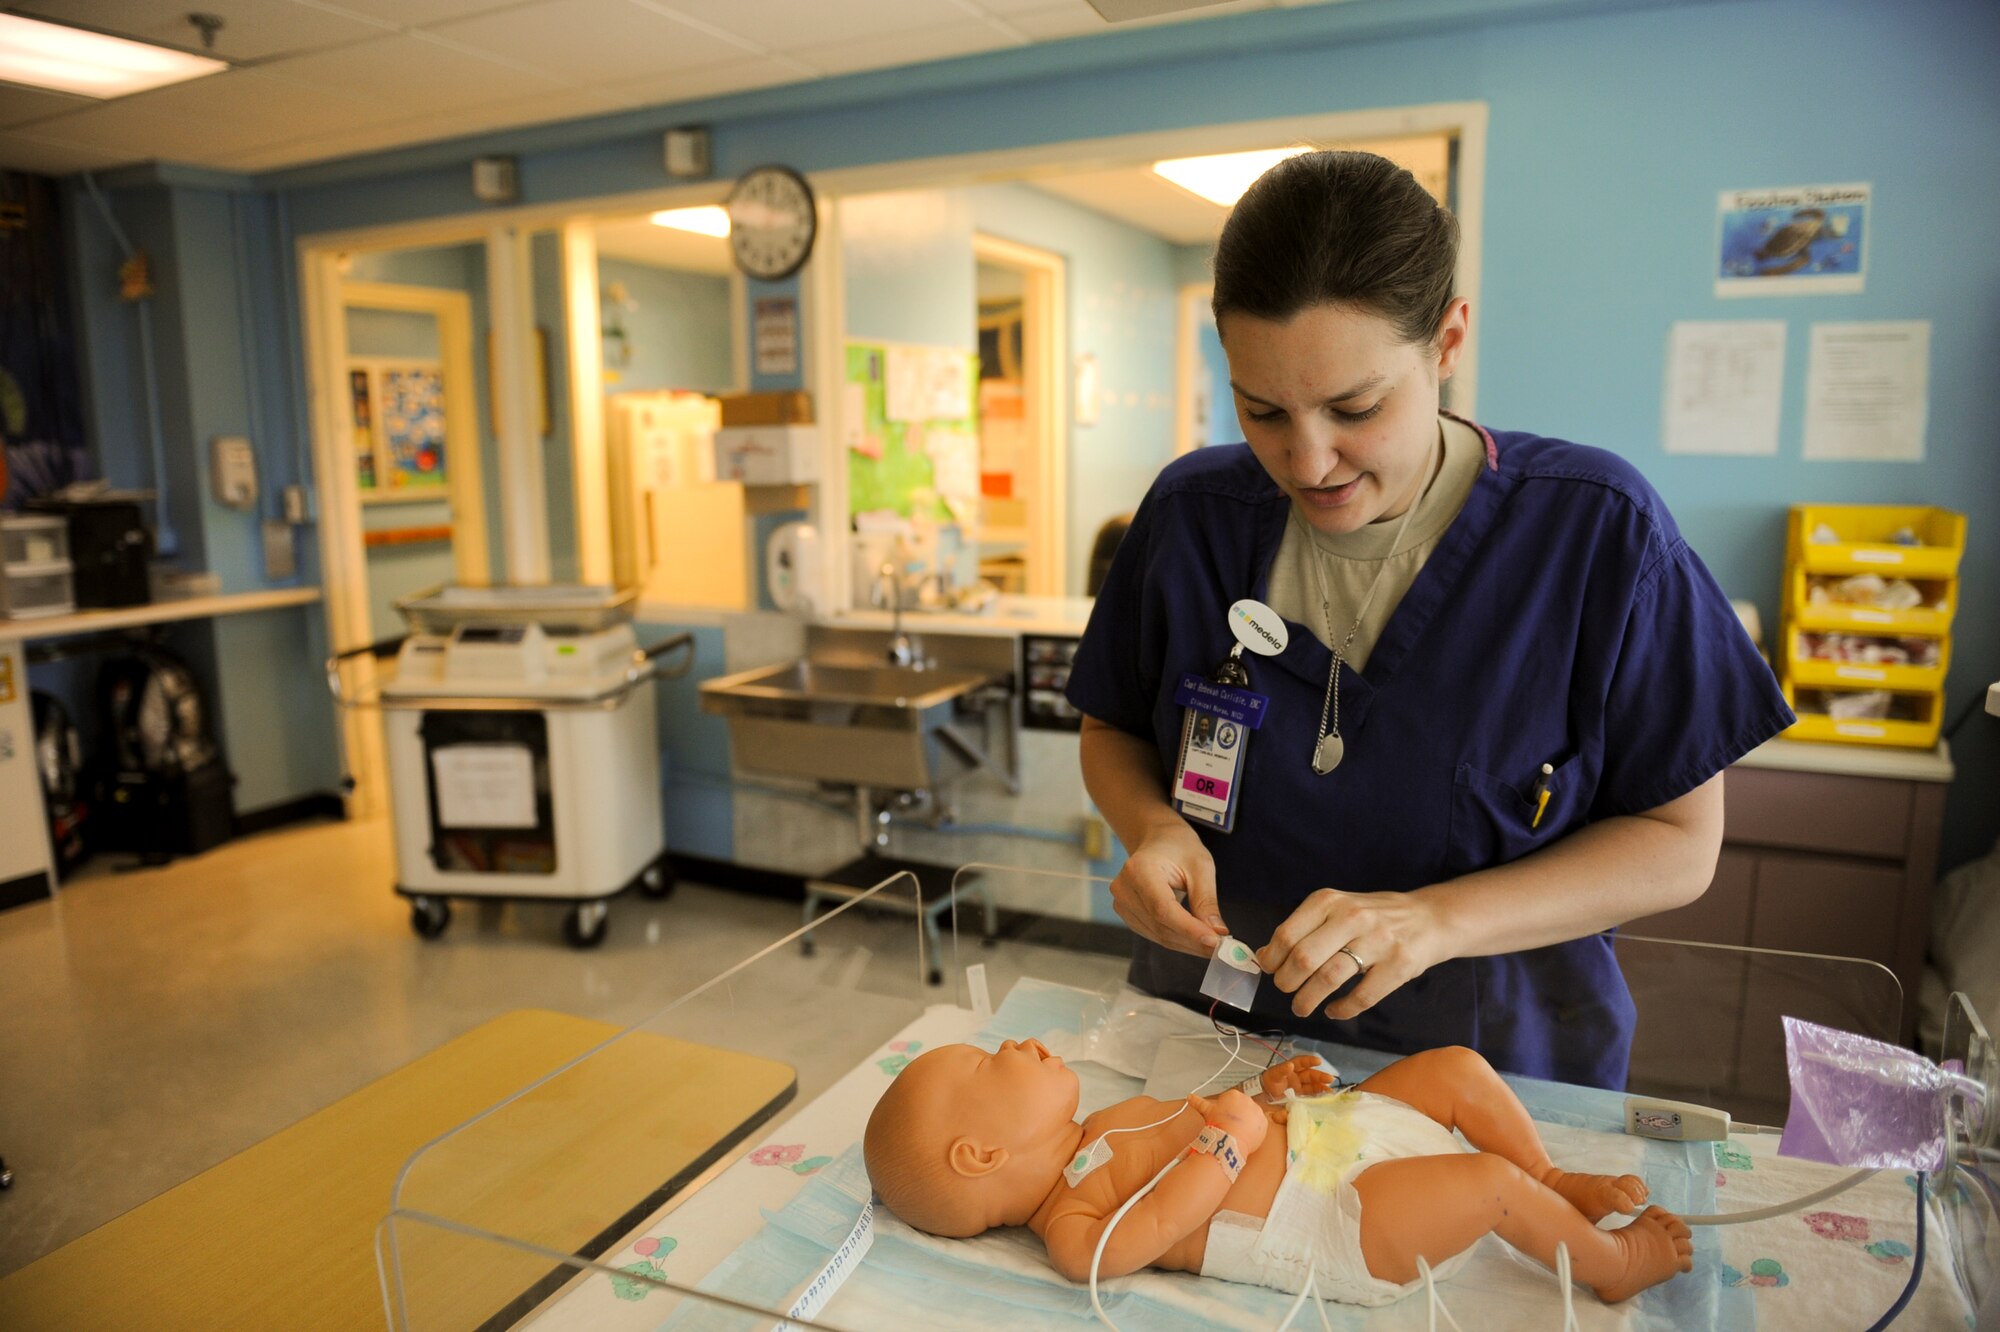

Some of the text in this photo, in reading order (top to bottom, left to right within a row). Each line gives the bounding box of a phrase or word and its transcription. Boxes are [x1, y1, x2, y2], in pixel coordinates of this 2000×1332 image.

[1249, 619, 1283, 650] medela
[1196, 778, 1215, 795] OR
[854, 1229, 863, 1240] 40
[842, 1246, 850, 1259] 42
[834, 1255, 843, 1268] 43
[826, 1265, 835, 1278] 44
[817, 1275, 827, 1289] 45
[809, 1286, 818, 1298] 46
[801, 1296, 809, 1310] 47
